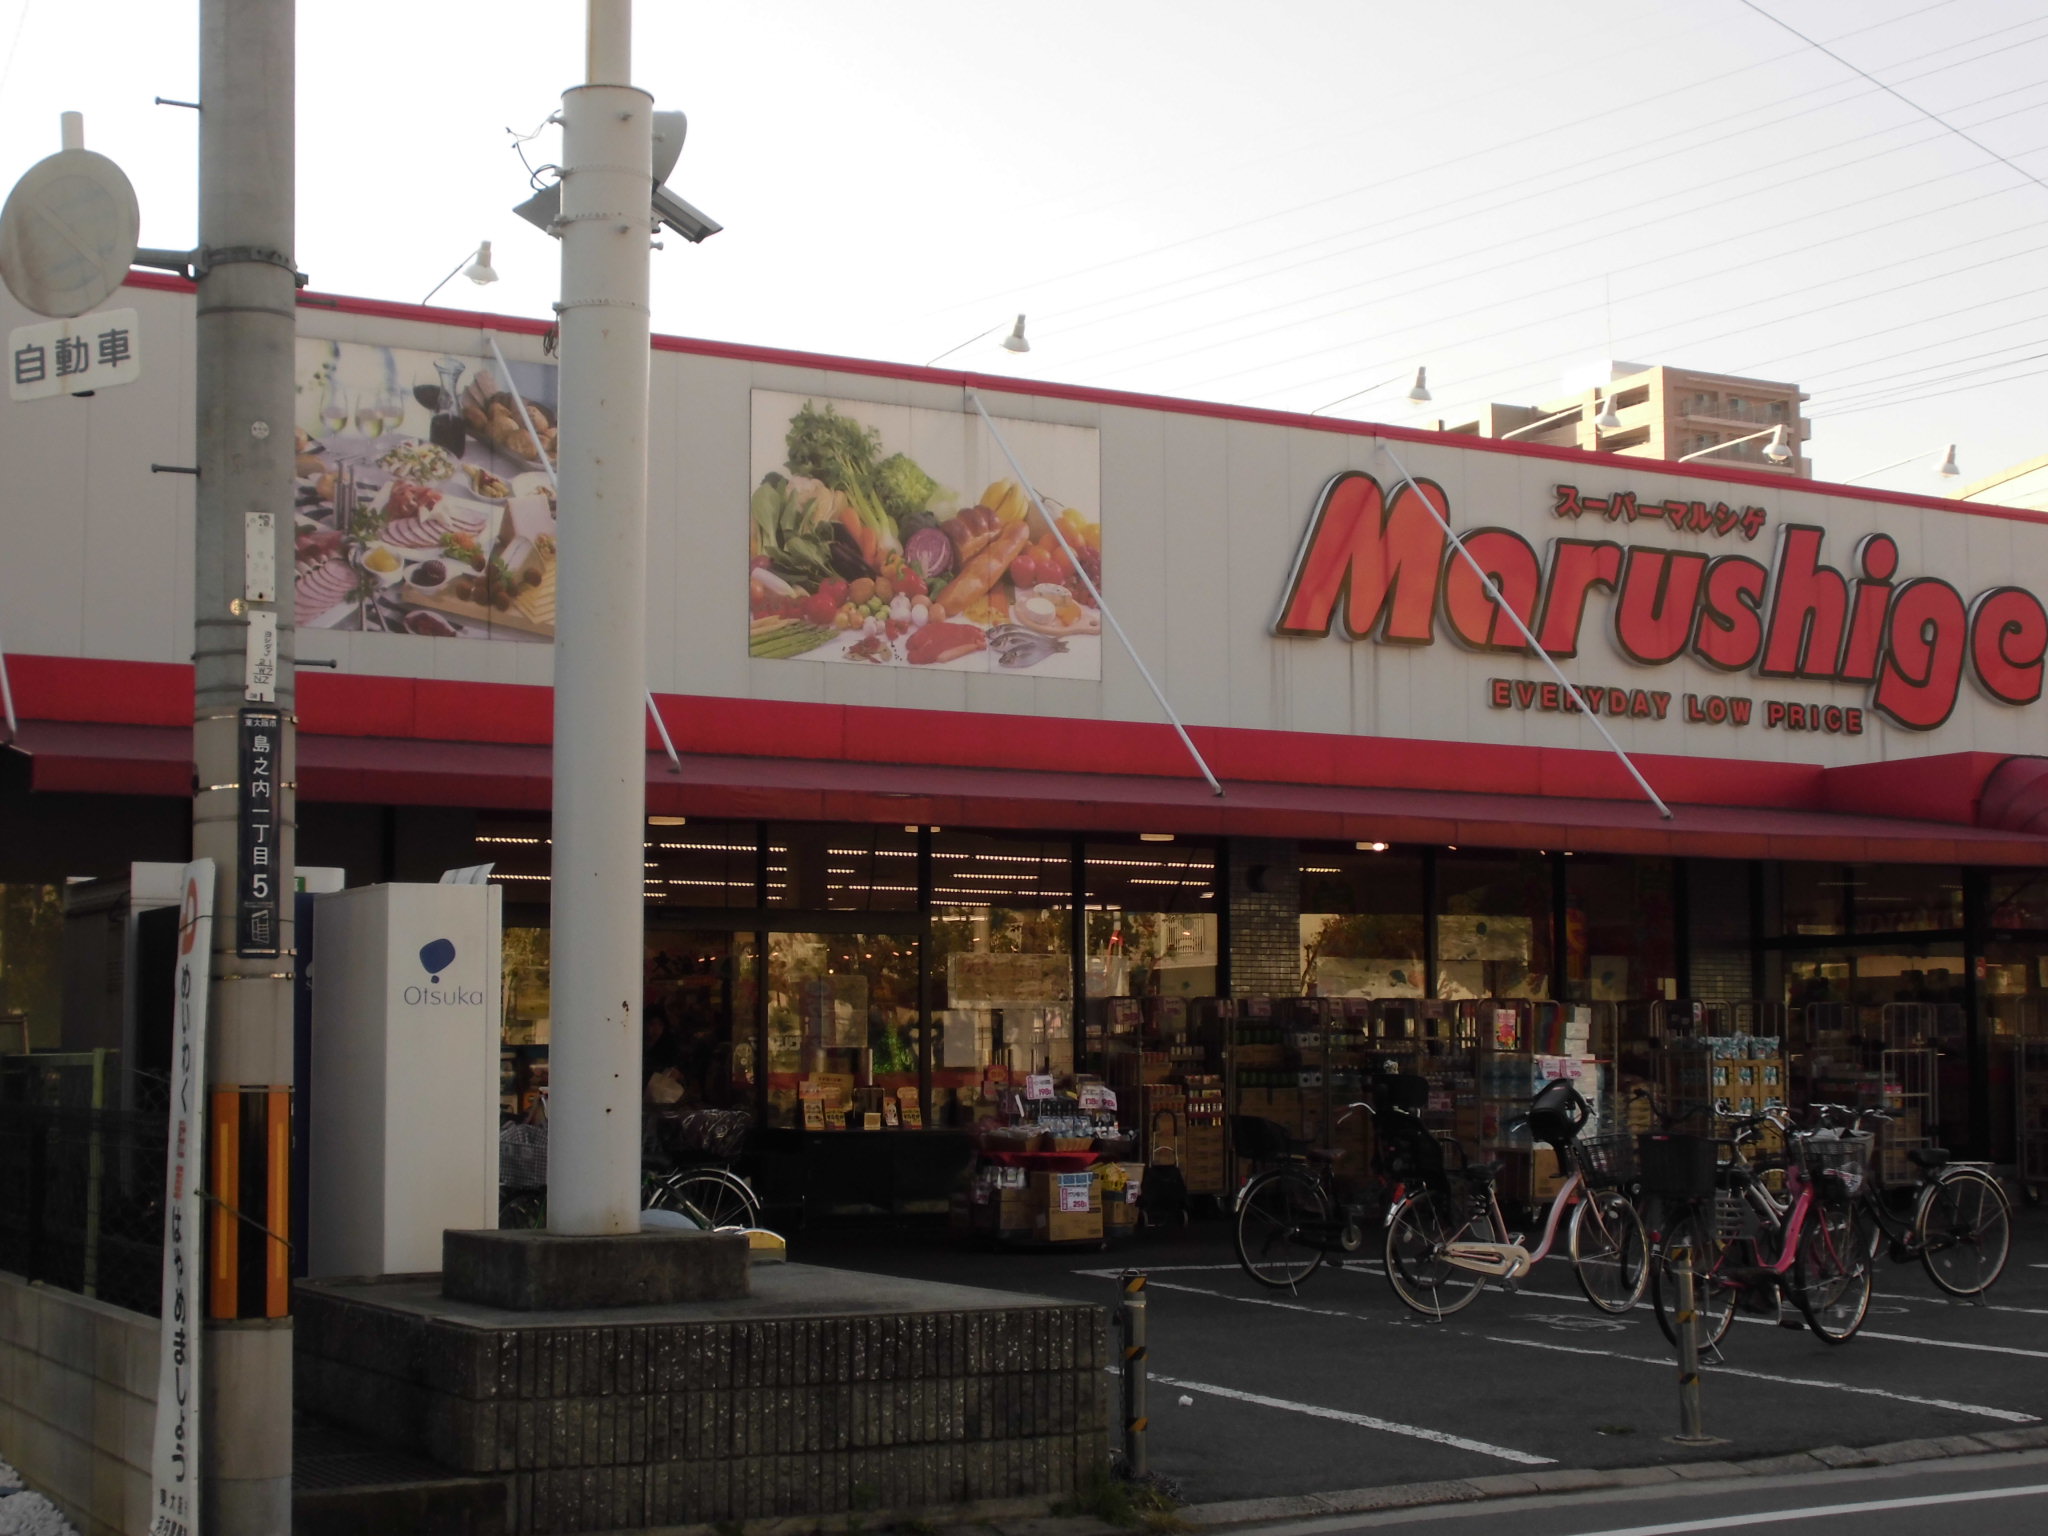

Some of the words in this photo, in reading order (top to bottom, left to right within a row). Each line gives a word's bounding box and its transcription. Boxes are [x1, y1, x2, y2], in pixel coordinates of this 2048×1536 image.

[13, 327, 131, 385] 自動車
[1555, 484, 1767, 541] スーパーマルシゲ
[1272, 470, 2048, 731] Marushige
[1488, 677, 1671, 720] EVERYDAY
[1684, 692, 1753, 727] LOW
[1763, 700, 1864, 736] PRICE
[251, 734, 271, 898] 島之内一丁目5
[403, 985, 483, 1006] Otsuka
